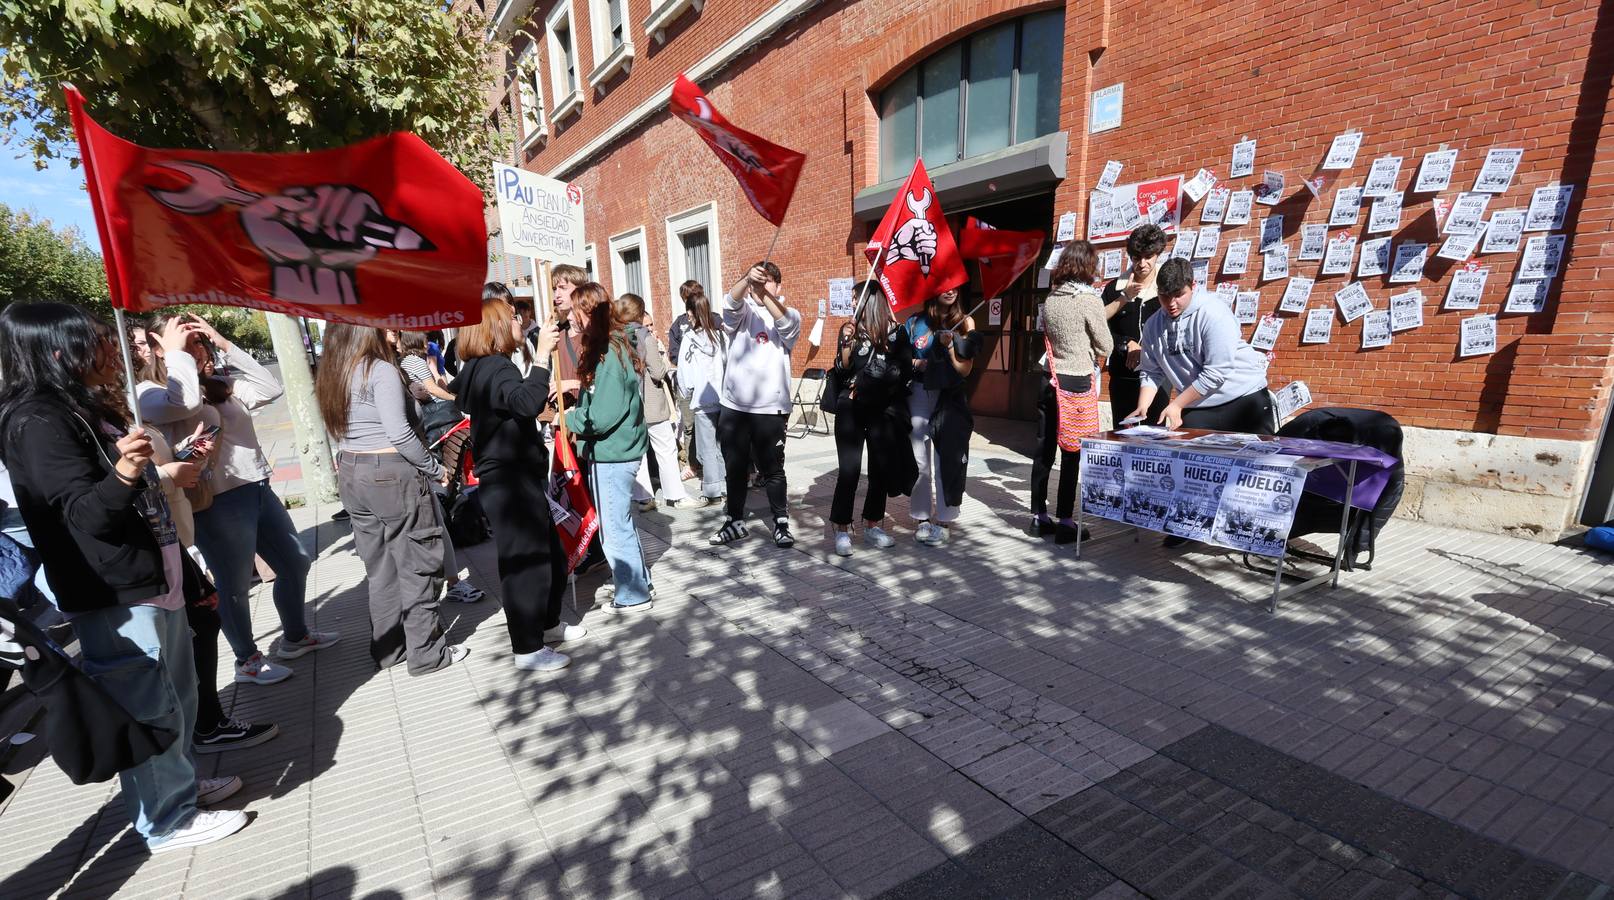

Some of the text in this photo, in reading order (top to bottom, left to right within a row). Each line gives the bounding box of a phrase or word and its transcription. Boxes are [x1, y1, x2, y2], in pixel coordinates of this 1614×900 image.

[1096, 85, 1121, 98] ALARMA
[1491, 157, 1515, 165] HUELGA
[498, 168, 533, 205] ¡PAU
[537, 188, 559, 211] PLAN
[522, 208, 570, 233] ANSIEDAD
[1087, 454, 1122, 468] HUELGA
[1188, 453, 1195, 461] 11
[1204, 456, 1233, 466] OCTUBRE
[1131, 460, 1172, 475] HUELGA
[1184, 466, 1228, 484] HUELGA
[1236, 472, 1292, 495] HUELGA
